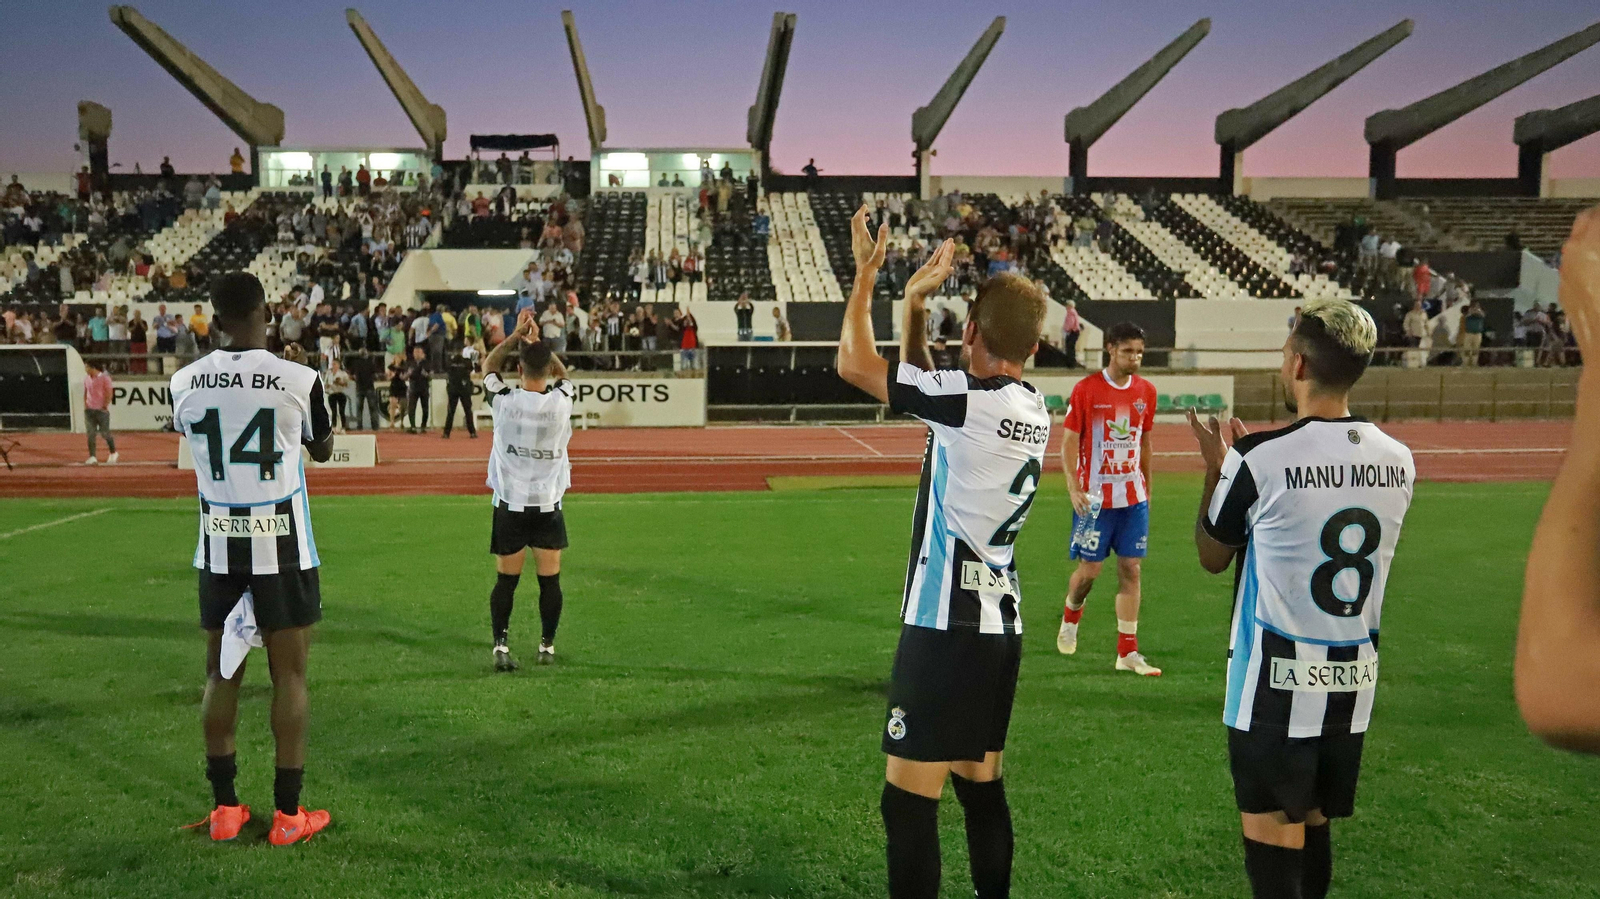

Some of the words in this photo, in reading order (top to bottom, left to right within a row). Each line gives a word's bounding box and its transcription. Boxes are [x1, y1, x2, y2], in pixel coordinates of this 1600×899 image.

[190, 372, 244, 390] MUSA
[251, 373, 286, 392] BK.
[189, 407, 285, 482] 14
[1284, 465, 1344, 490] MANU
[1350, 464, 1406, 488] MOLINA
[988, 457, 1042, 547] 2
[211, 517, 288, 534] SERRANA
[1310, 505, 1382, 619] 8
[963, 564, 982, 587] LA
[1273, 661, 1300, 687] LA
